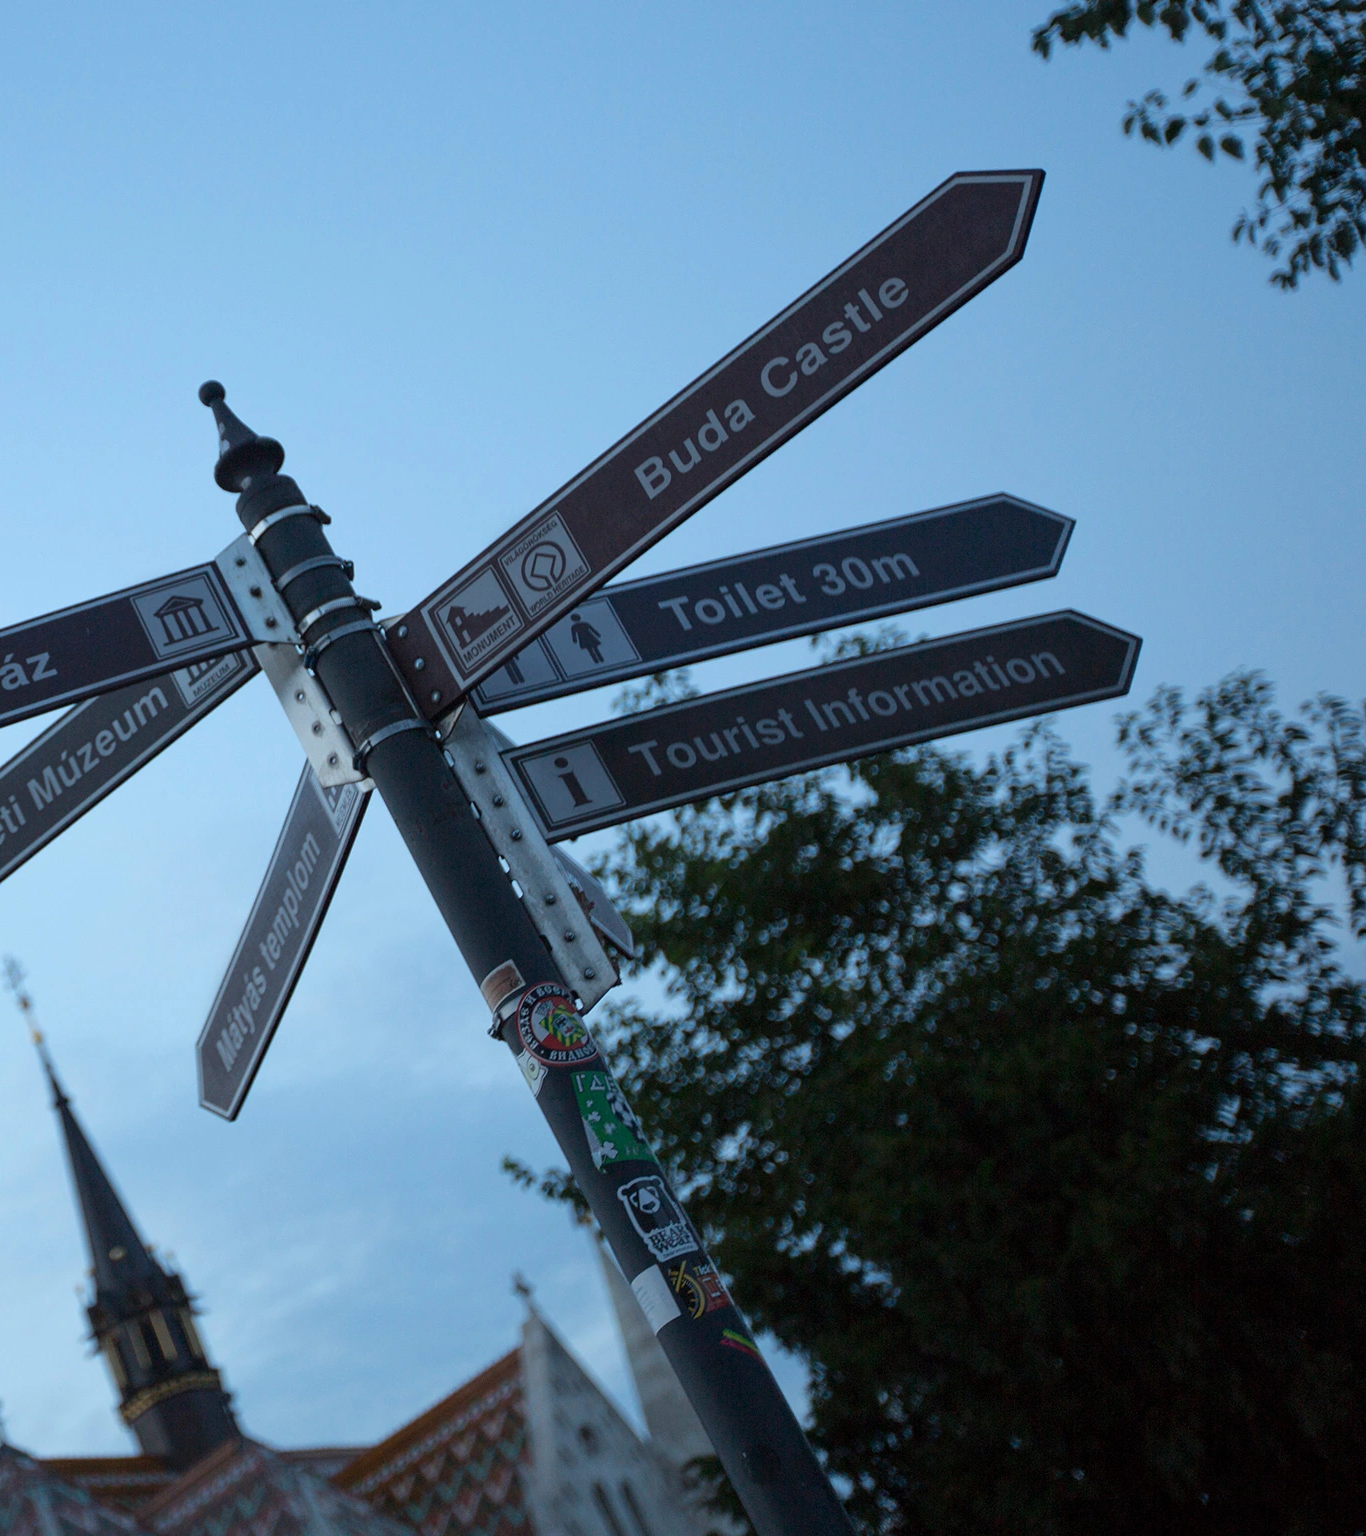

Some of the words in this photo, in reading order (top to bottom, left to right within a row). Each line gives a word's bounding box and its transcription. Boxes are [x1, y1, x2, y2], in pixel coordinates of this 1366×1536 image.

[634, 399, 756, 500] Buda
[760, 277, 909, 398] Castle
[462, 615, 517, 664] MONUMENT
[529, 590, 554, 613] WORLD
[553, 565, 585, 594] HERITAGE
[657, 573, 807, 631] Toilet
[812, 552, 920, 596] 30m
[26, 686, 169, 811] Múzeum
[627, 707, 802, 776] Tourist
[803, 651, 1066, 732] Information
[215, 965, 268, 1073] Mátyás
[259, 831, 321, 970] templom
